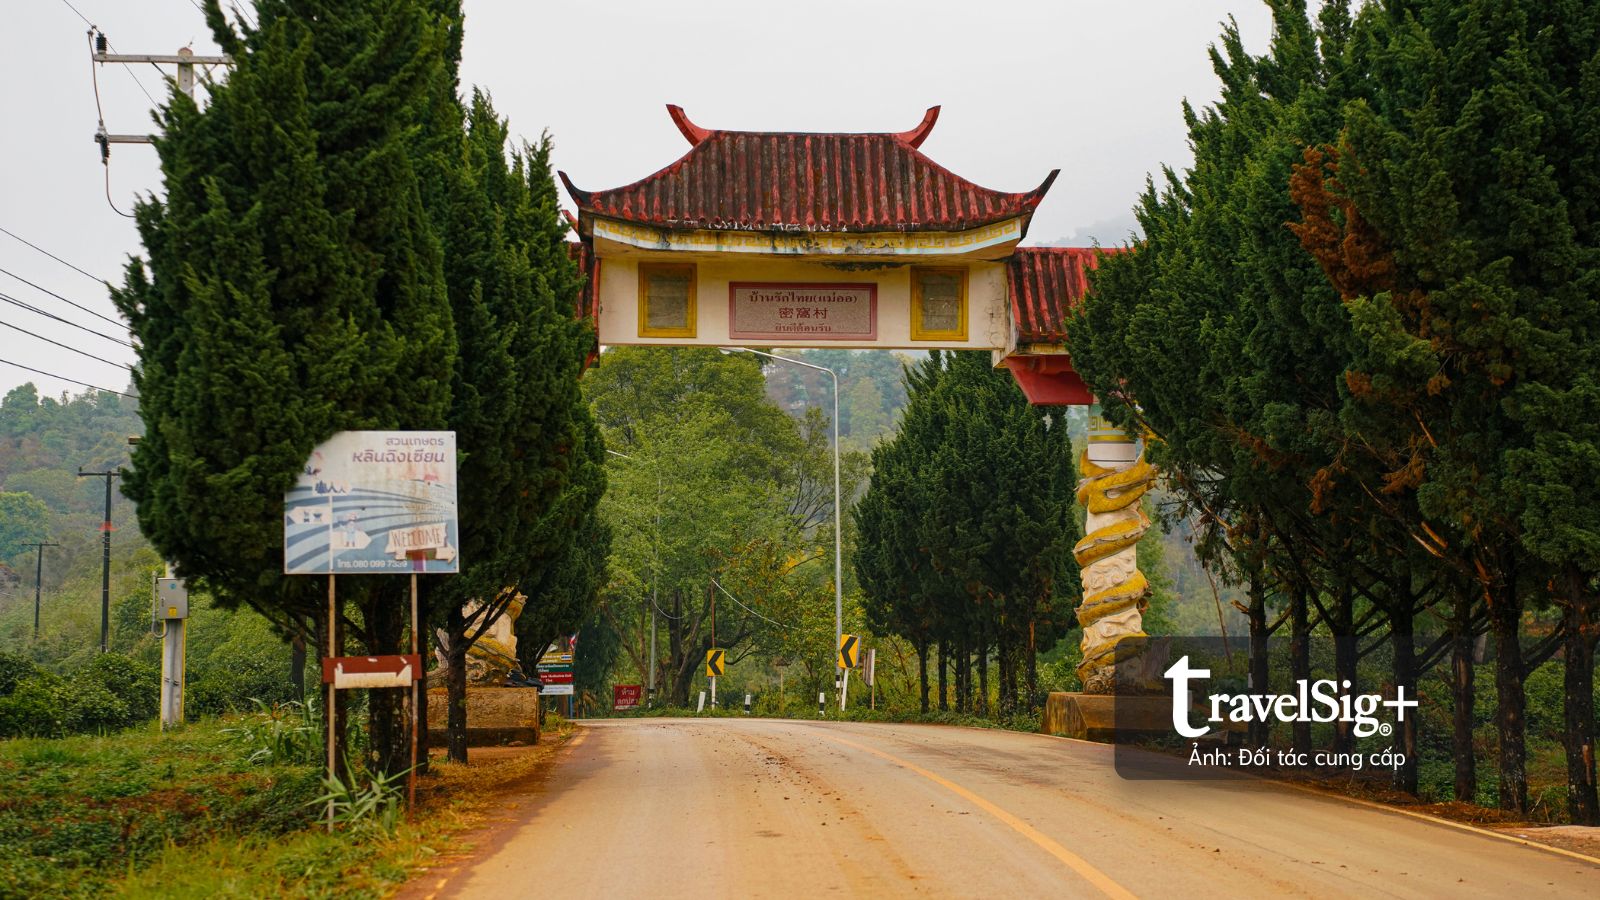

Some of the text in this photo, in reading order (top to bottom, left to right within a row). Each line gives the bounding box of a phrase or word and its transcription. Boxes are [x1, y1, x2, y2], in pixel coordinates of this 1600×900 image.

[750, 290, 857, 304] บ้านรักไทย(แม่ออ)
[779, 307, 829, 319] 密窩村
[385, 437, 445, 446] สวนเกษตร
[391, 527, 441, 547] WELCOME
